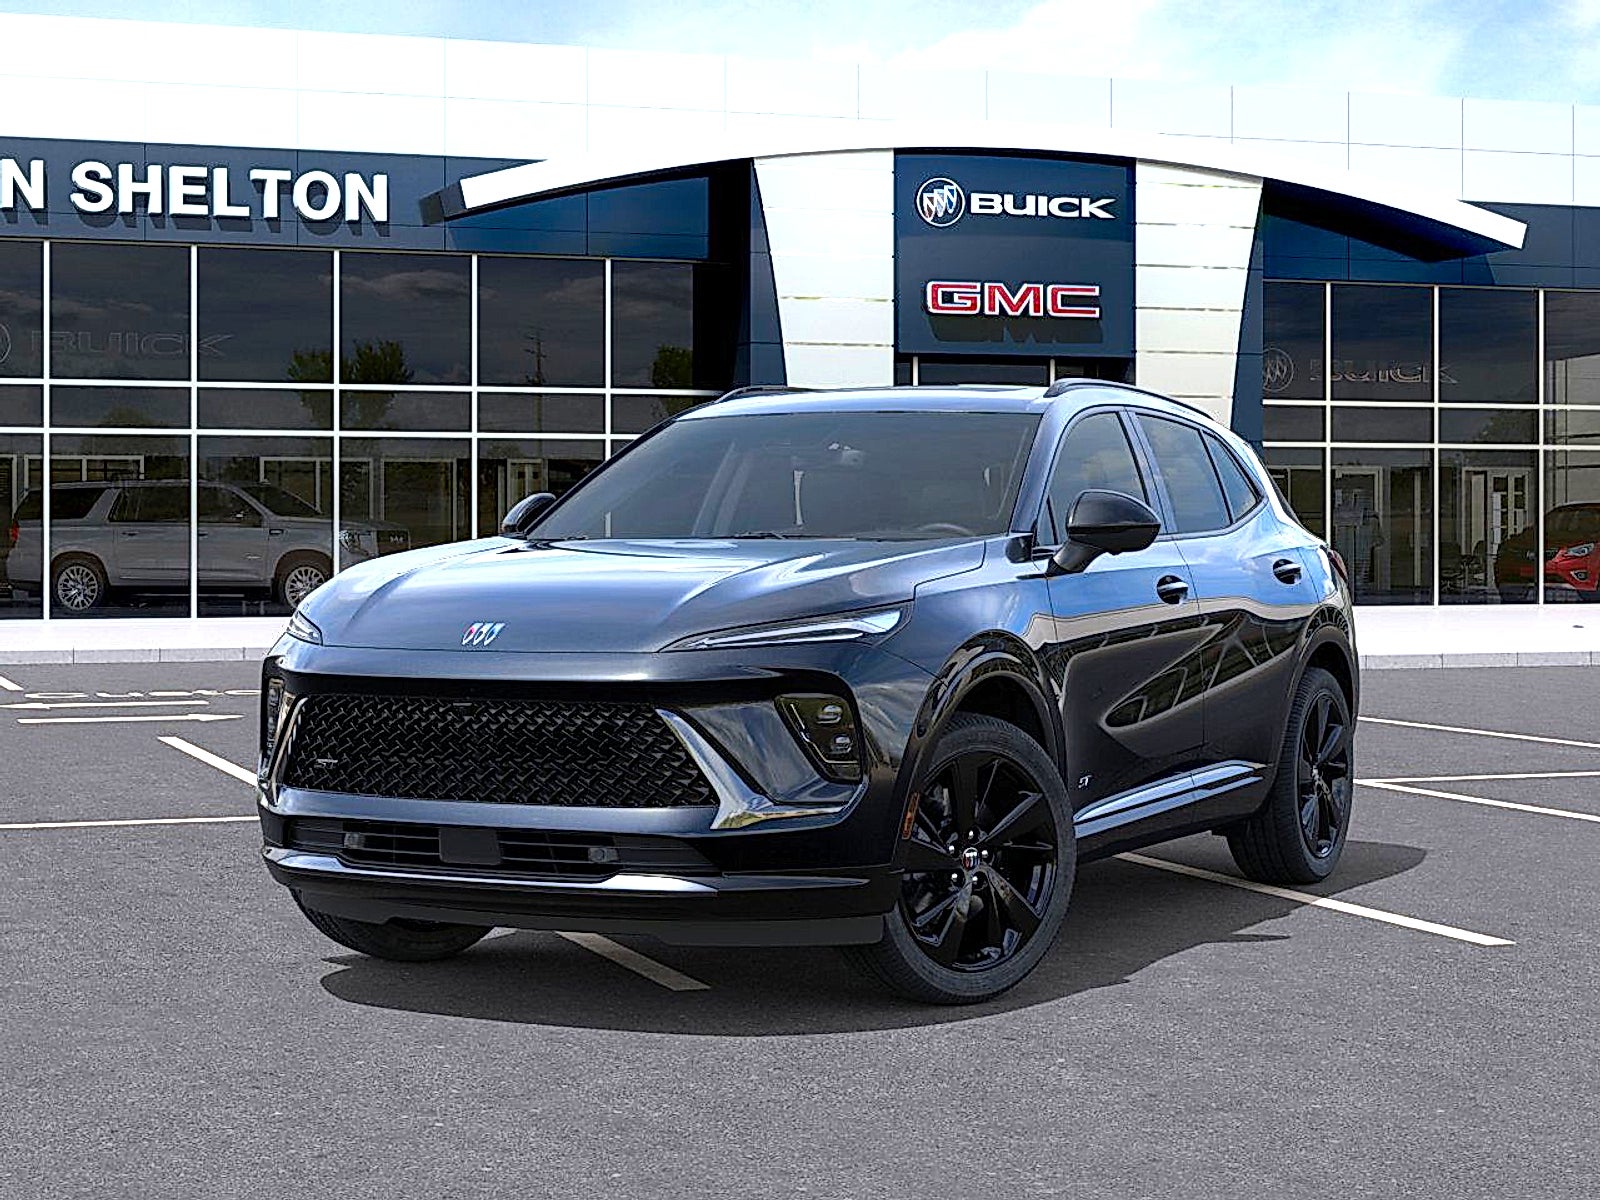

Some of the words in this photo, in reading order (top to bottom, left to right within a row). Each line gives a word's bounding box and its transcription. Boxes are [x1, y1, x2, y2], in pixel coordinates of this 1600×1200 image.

[69, 160, 389, 222] SHELTON
[969, 192, 1117, 220] BUICK
[926, 280, 1101, 318] GMC
